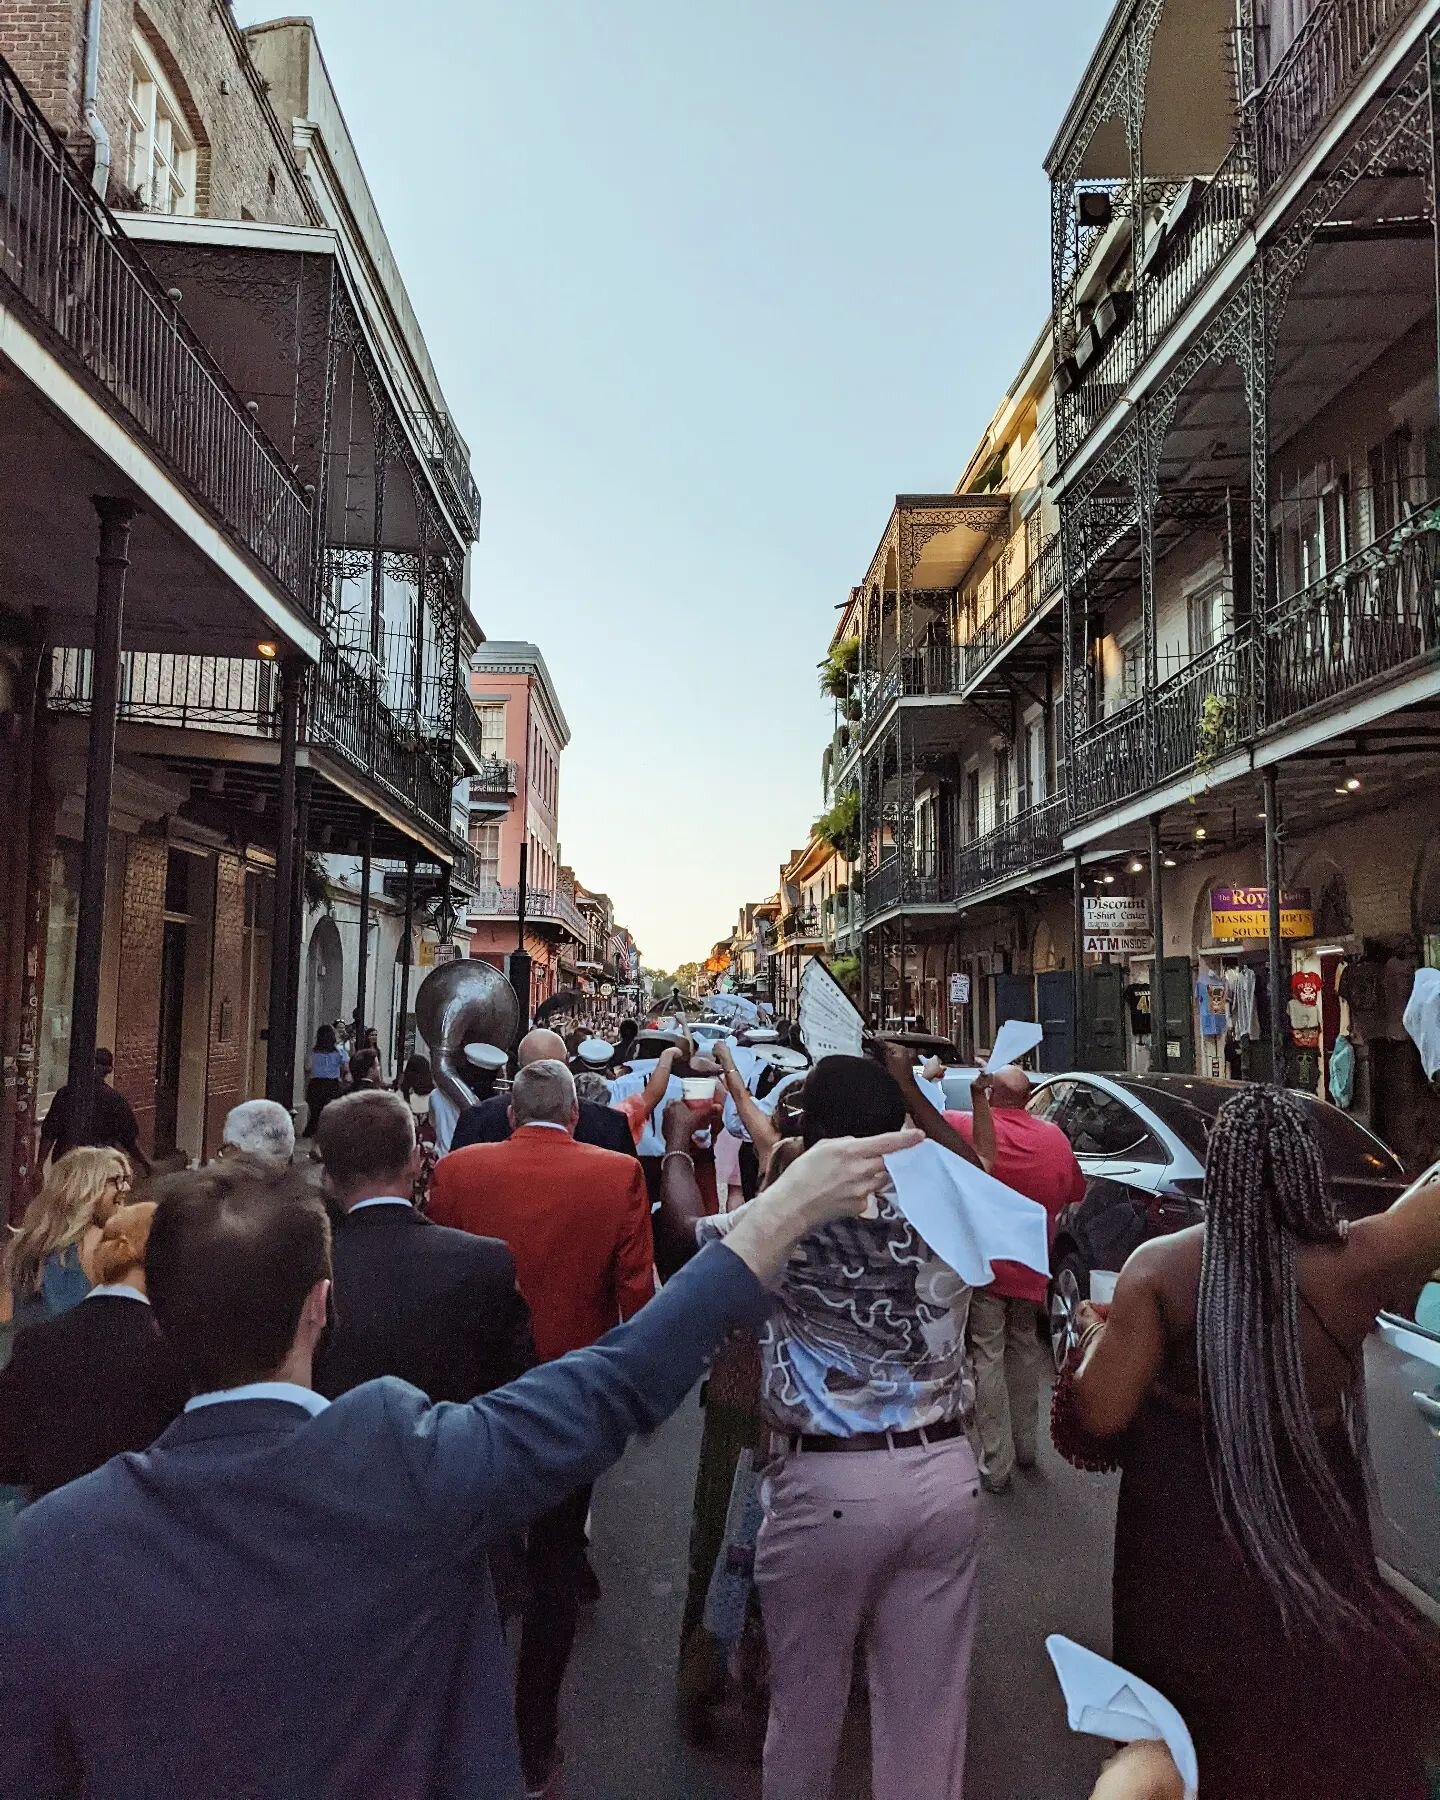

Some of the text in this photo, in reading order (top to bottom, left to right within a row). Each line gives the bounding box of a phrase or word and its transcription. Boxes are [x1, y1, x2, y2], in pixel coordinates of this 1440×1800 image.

[1087, 898, 1146, 909] Discount
[1232, 889, 1283, 908] Royl
[1088, 911, 1147, 920] T-Shirt Center
[1215, 914, 1253, 923] MASKS
[1087, 938, 1148, 951] ATM INSIDE
